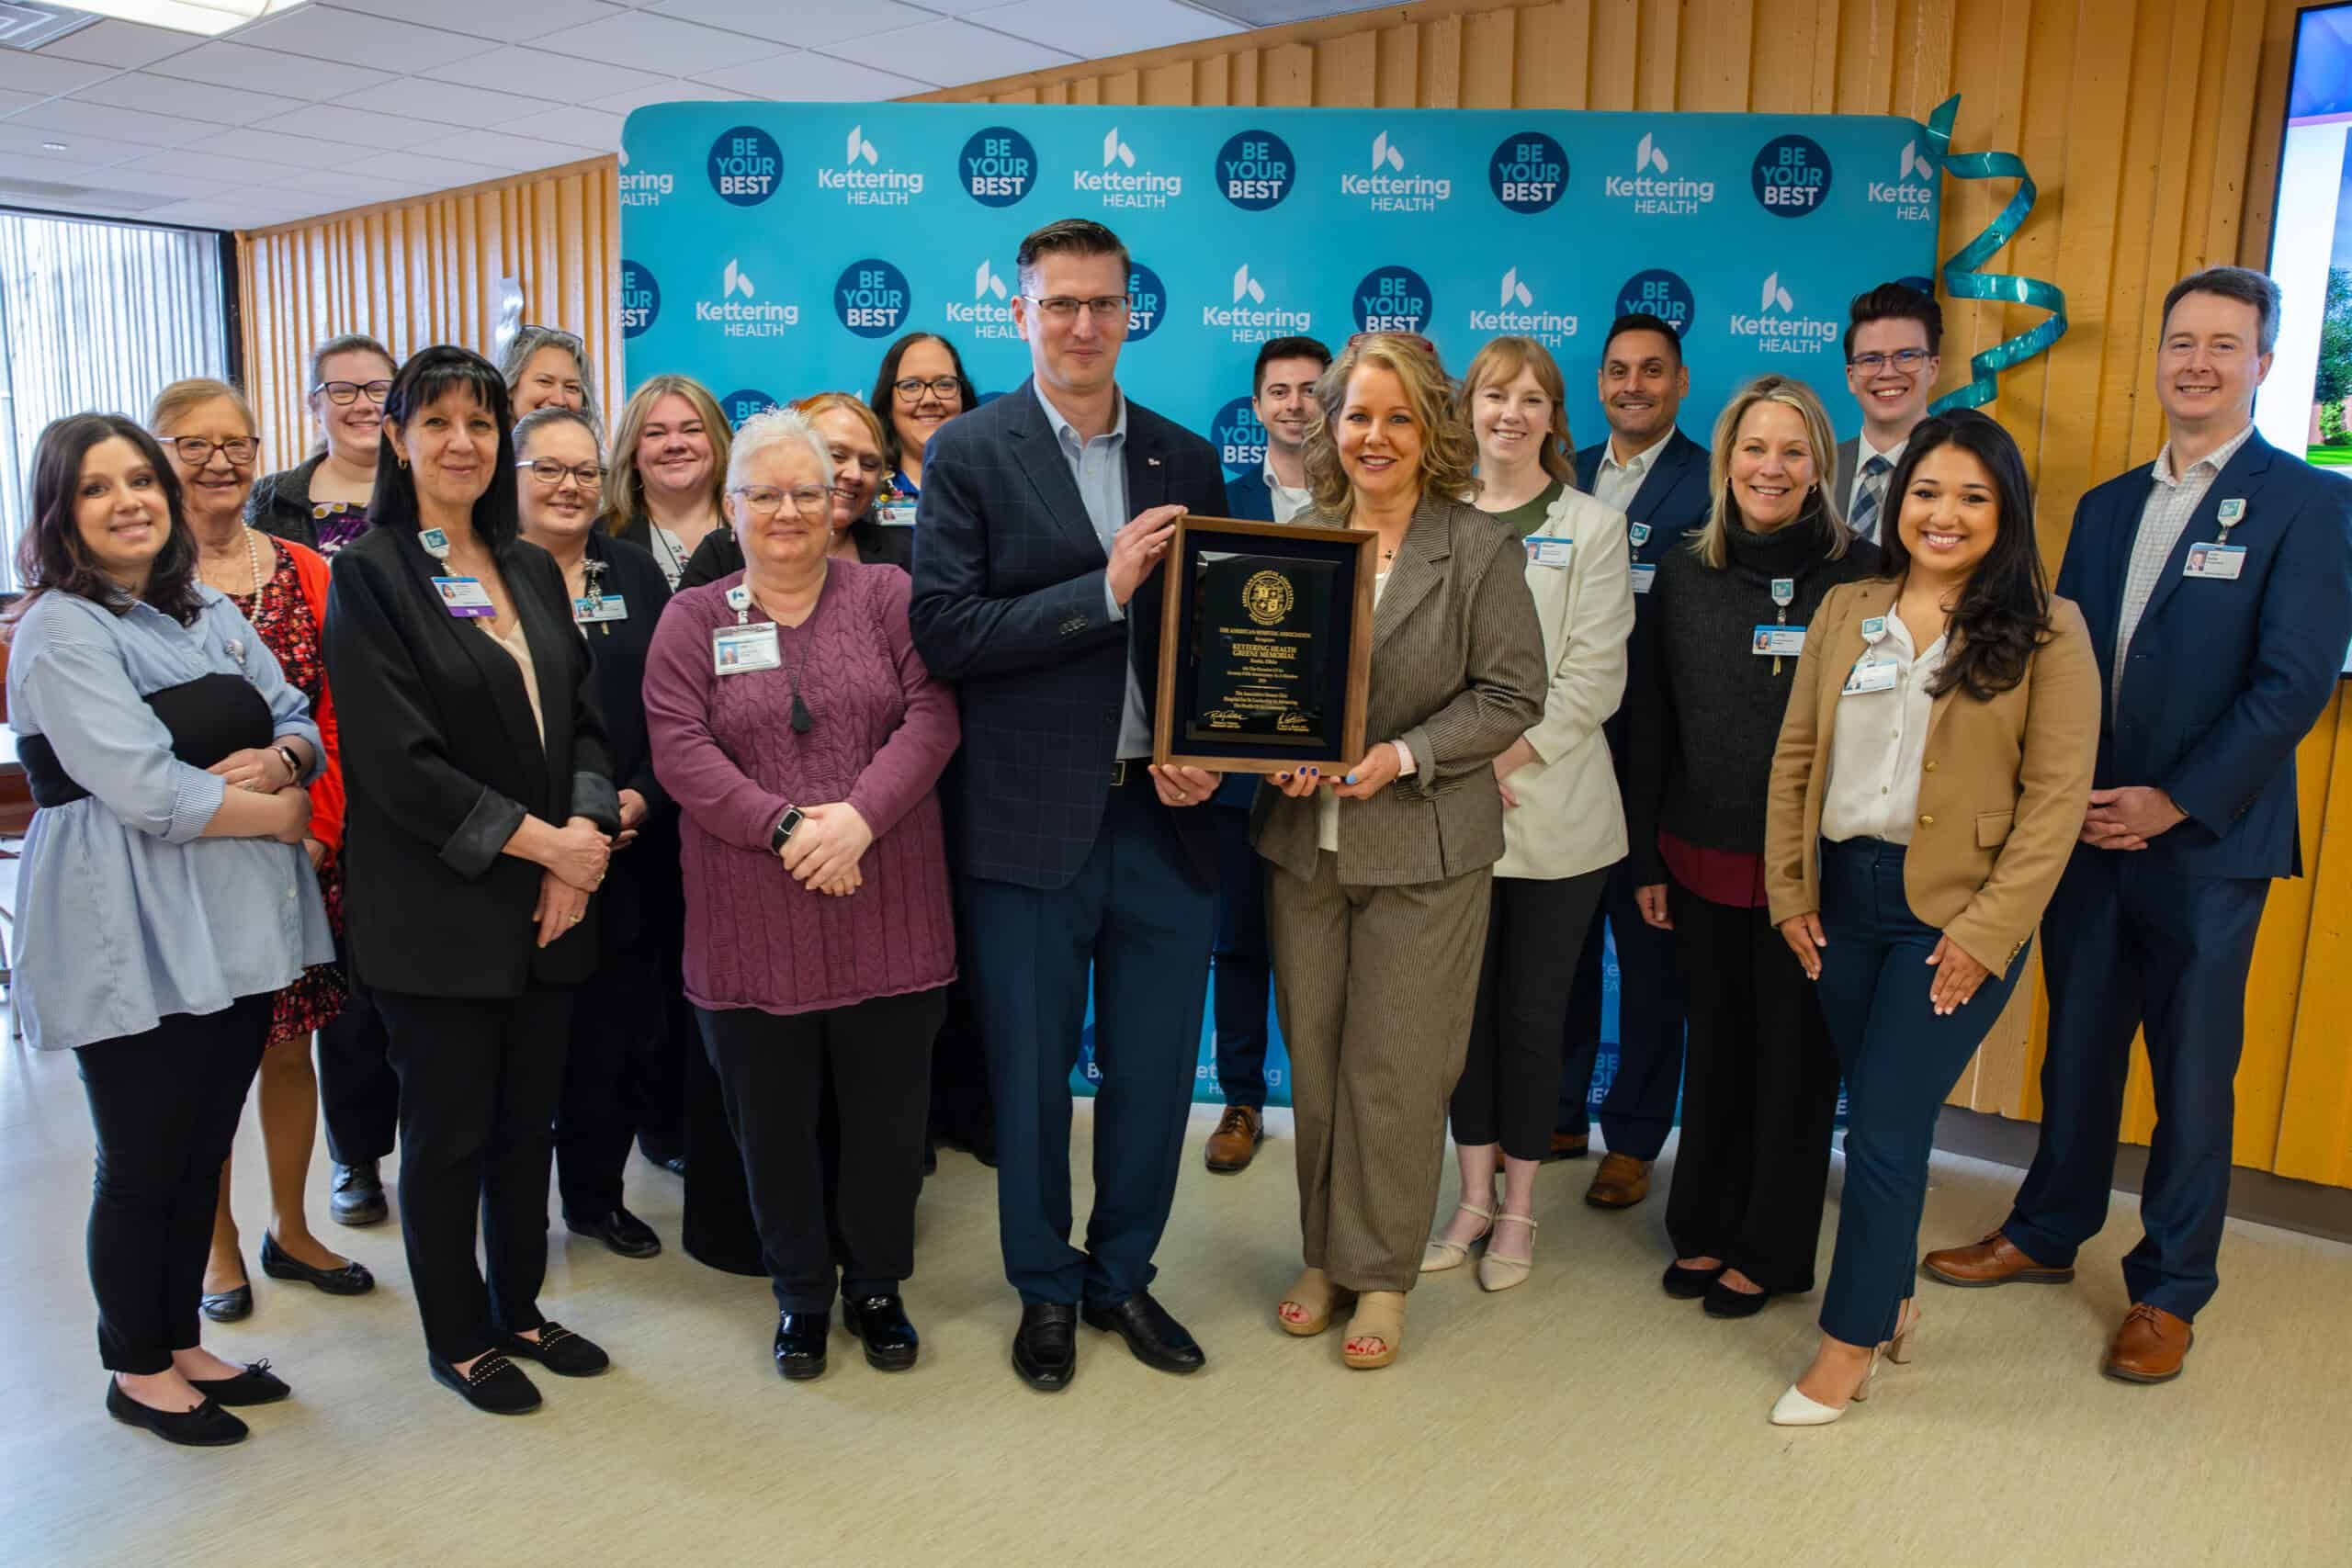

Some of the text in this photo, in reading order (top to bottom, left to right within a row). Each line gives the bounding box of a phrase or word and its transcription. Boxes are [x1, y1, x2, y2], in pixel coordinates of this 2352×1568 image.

[732, 139, 758, 156] BE
[985, 140, 1011, 157] BE
[1242, 142, 1269, 160] BE
[1517, 144, 1544, 162] BE
[1779, 147, 1805, 166] BE
[716, 158, 775, 175] YOUR
[967, 158, 1029, 176] YOUR
[1226, 162, 1286, 180] YOUR
[1498, 164, 1560, 182] YOUR
[617, 170, 673, 194] ering
[818, 169, 924, 194] Kettering
[1073, 170, 1182, 197] Kettering
[1761, 166, 1823, 186] YOUR
[719, 176, 772, 195] BEST
[972, 177, 1024, 196] BEST
[1228, 180, 1283, 198] BEST
[1341, 175, 1451, 199] Kettering
[1502, 183, 1556, 201] BEST
[1605, 175, 1714, 203] Kettering
[1868, 183, 1932, 203] Kette
[619, 193, 659, 206] ALTH
[847, 192, 909, 205] HEALTH
[1103, 194, 1166, 208] HEALTH
[1371, 197, 1434, 211] HEALTH
[1764, 186, 1818, 206] BEST
[1634, 200, 1698, 214] HEALTH
[1897, 206, 1930, 220] HEA
[860, 270, 885, 288] BE
[1129, 274, 1140, 292] E
[1380, 277, 1407, 296] BE
[621, 290, 652, 308] UR
[843, 289, 903, 308] YOUR
[1644, 281, 1669, 299] BE
[1131, 294, 1159, 311] UR
[1363, 297, 1423, 315] YOUR
[1624, 300, 1686, 320] YOUR
[695, 300, 798, 324] Kettering
[847, 309, 899, 327] BEST
[945, 302, 1015, 322] Ketter
[1203, 307, 1311, 332] Kettering
[724, 323, 785, 337] HEALTH
[1127, 312, 1155, 331] ST
[1366, 316, 1419, 333] BEST
[1470, 310, 1578, 336] Kettering
[1730, 315, 1838, 342] Kettering
[975, 325, 1020, 339] HEAL
[1758, 339, 1821, 353] HEALTH
[1219, 426, 1266, 445] YOU
[1223, 445, 1268, 464] BES
